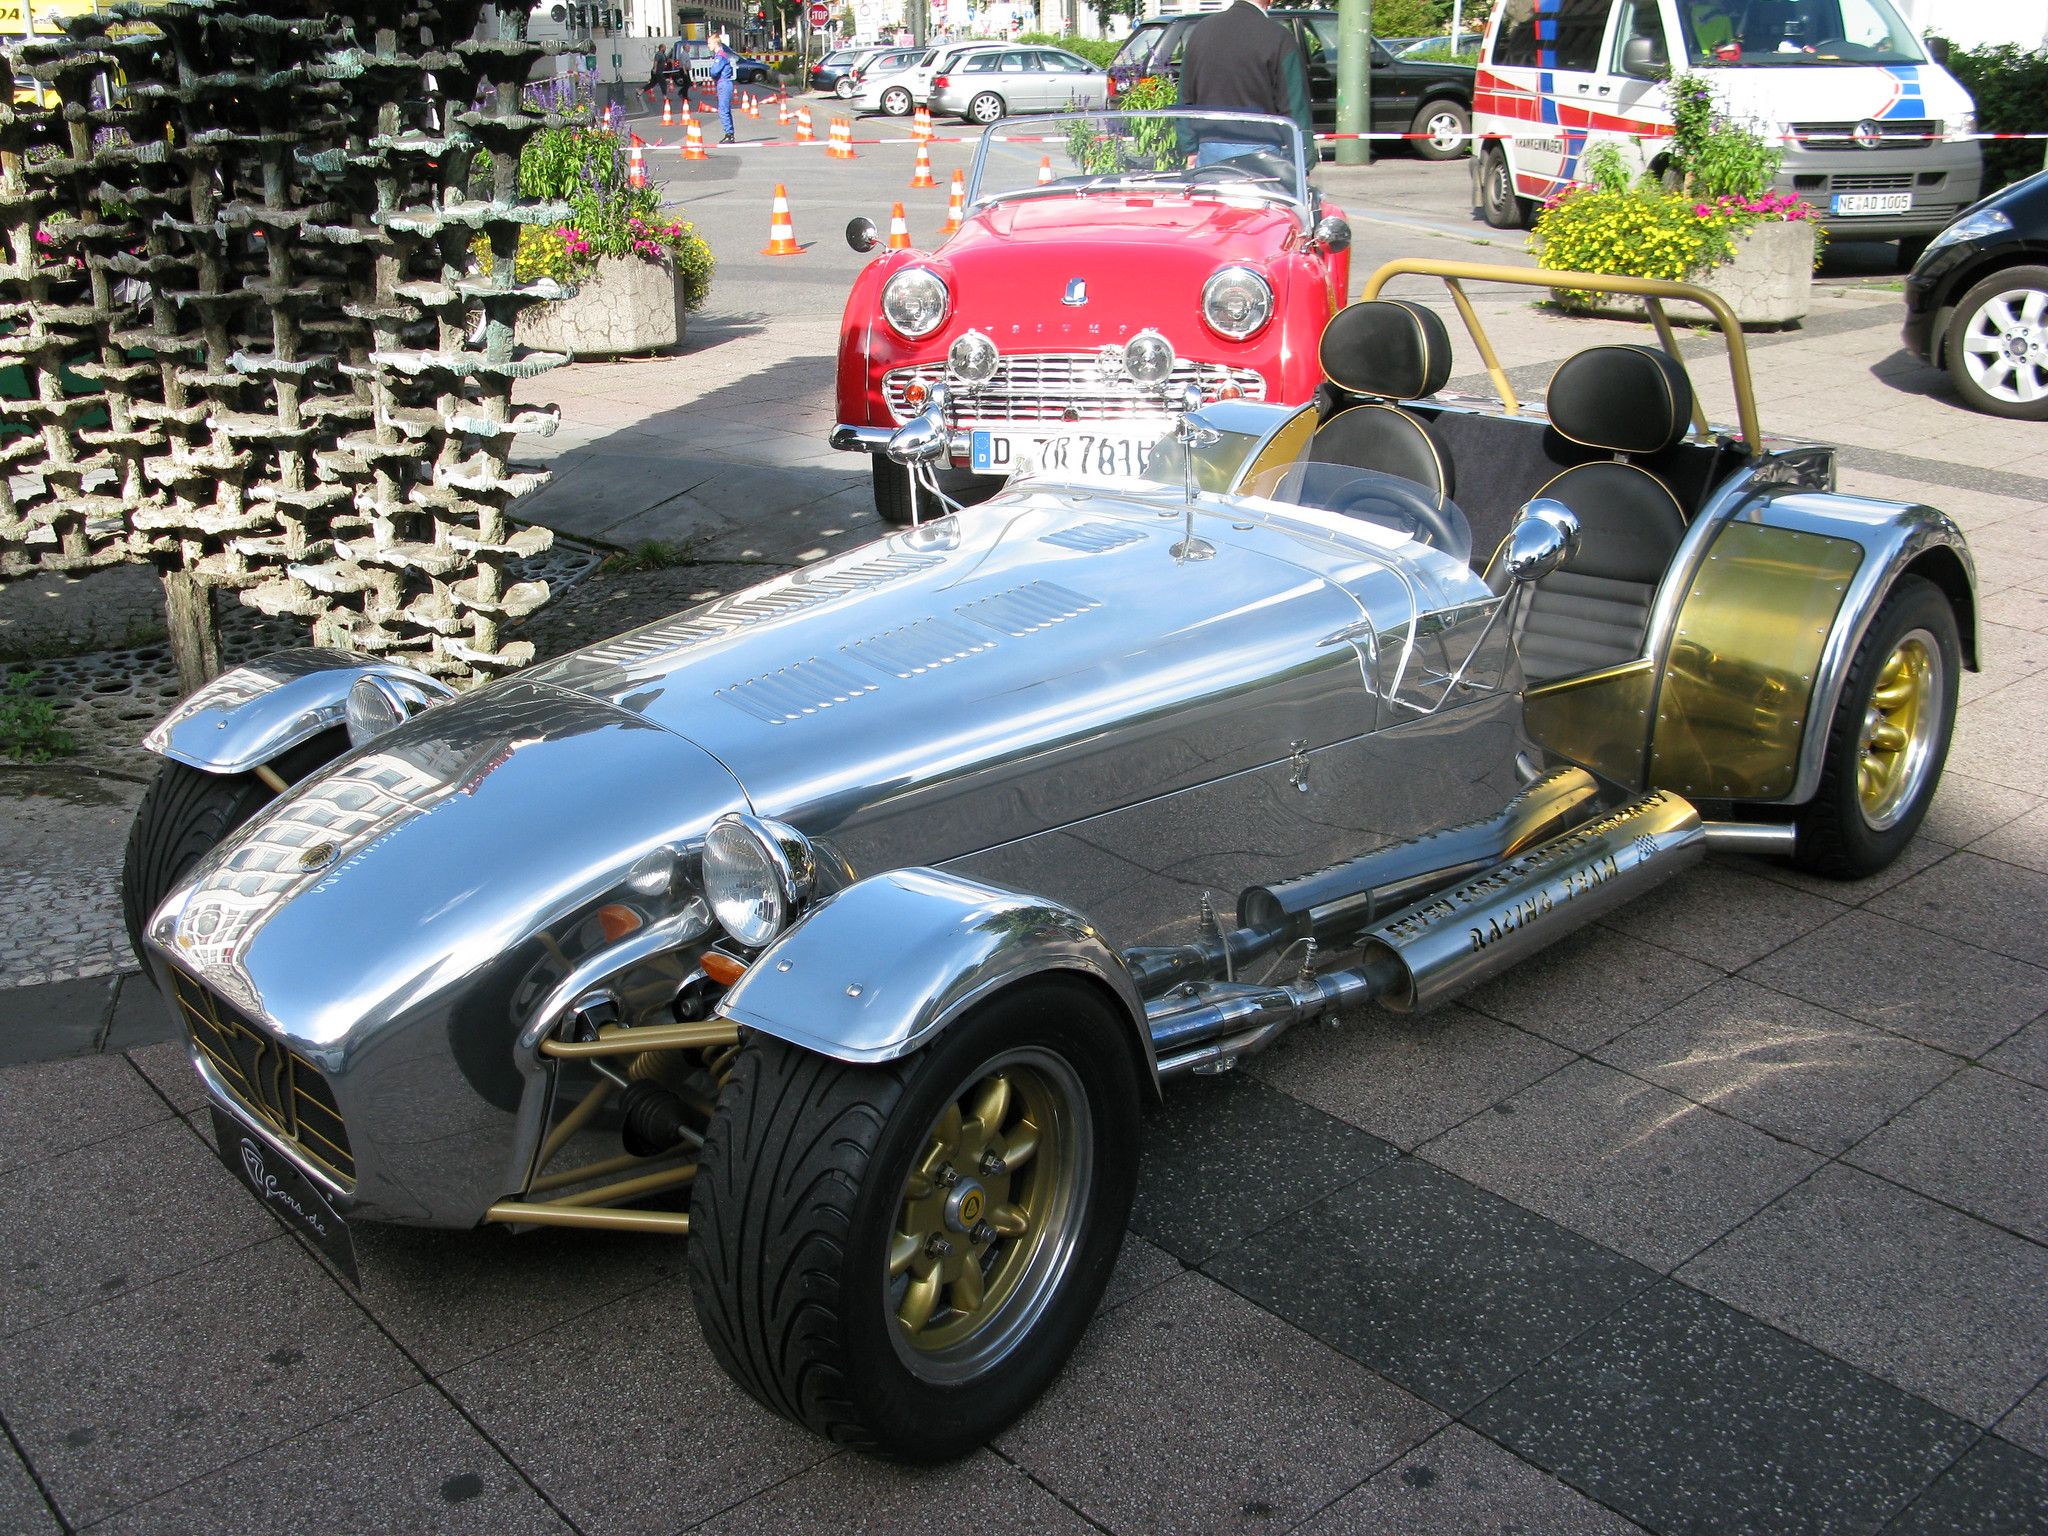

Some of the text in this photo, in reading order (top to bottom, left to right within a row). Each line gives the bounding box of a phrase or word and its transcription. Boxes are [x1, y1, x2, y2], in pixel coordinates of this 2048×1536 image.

[811, 10, 828, 20] STOP
[1840, 195, 1909, 210] NE AD 1005
[993, 438, 1010, 465] D
[1470, 854, 1618, 952] RACING TEAM
[1385, 899, 1457, 938] SEVEN
